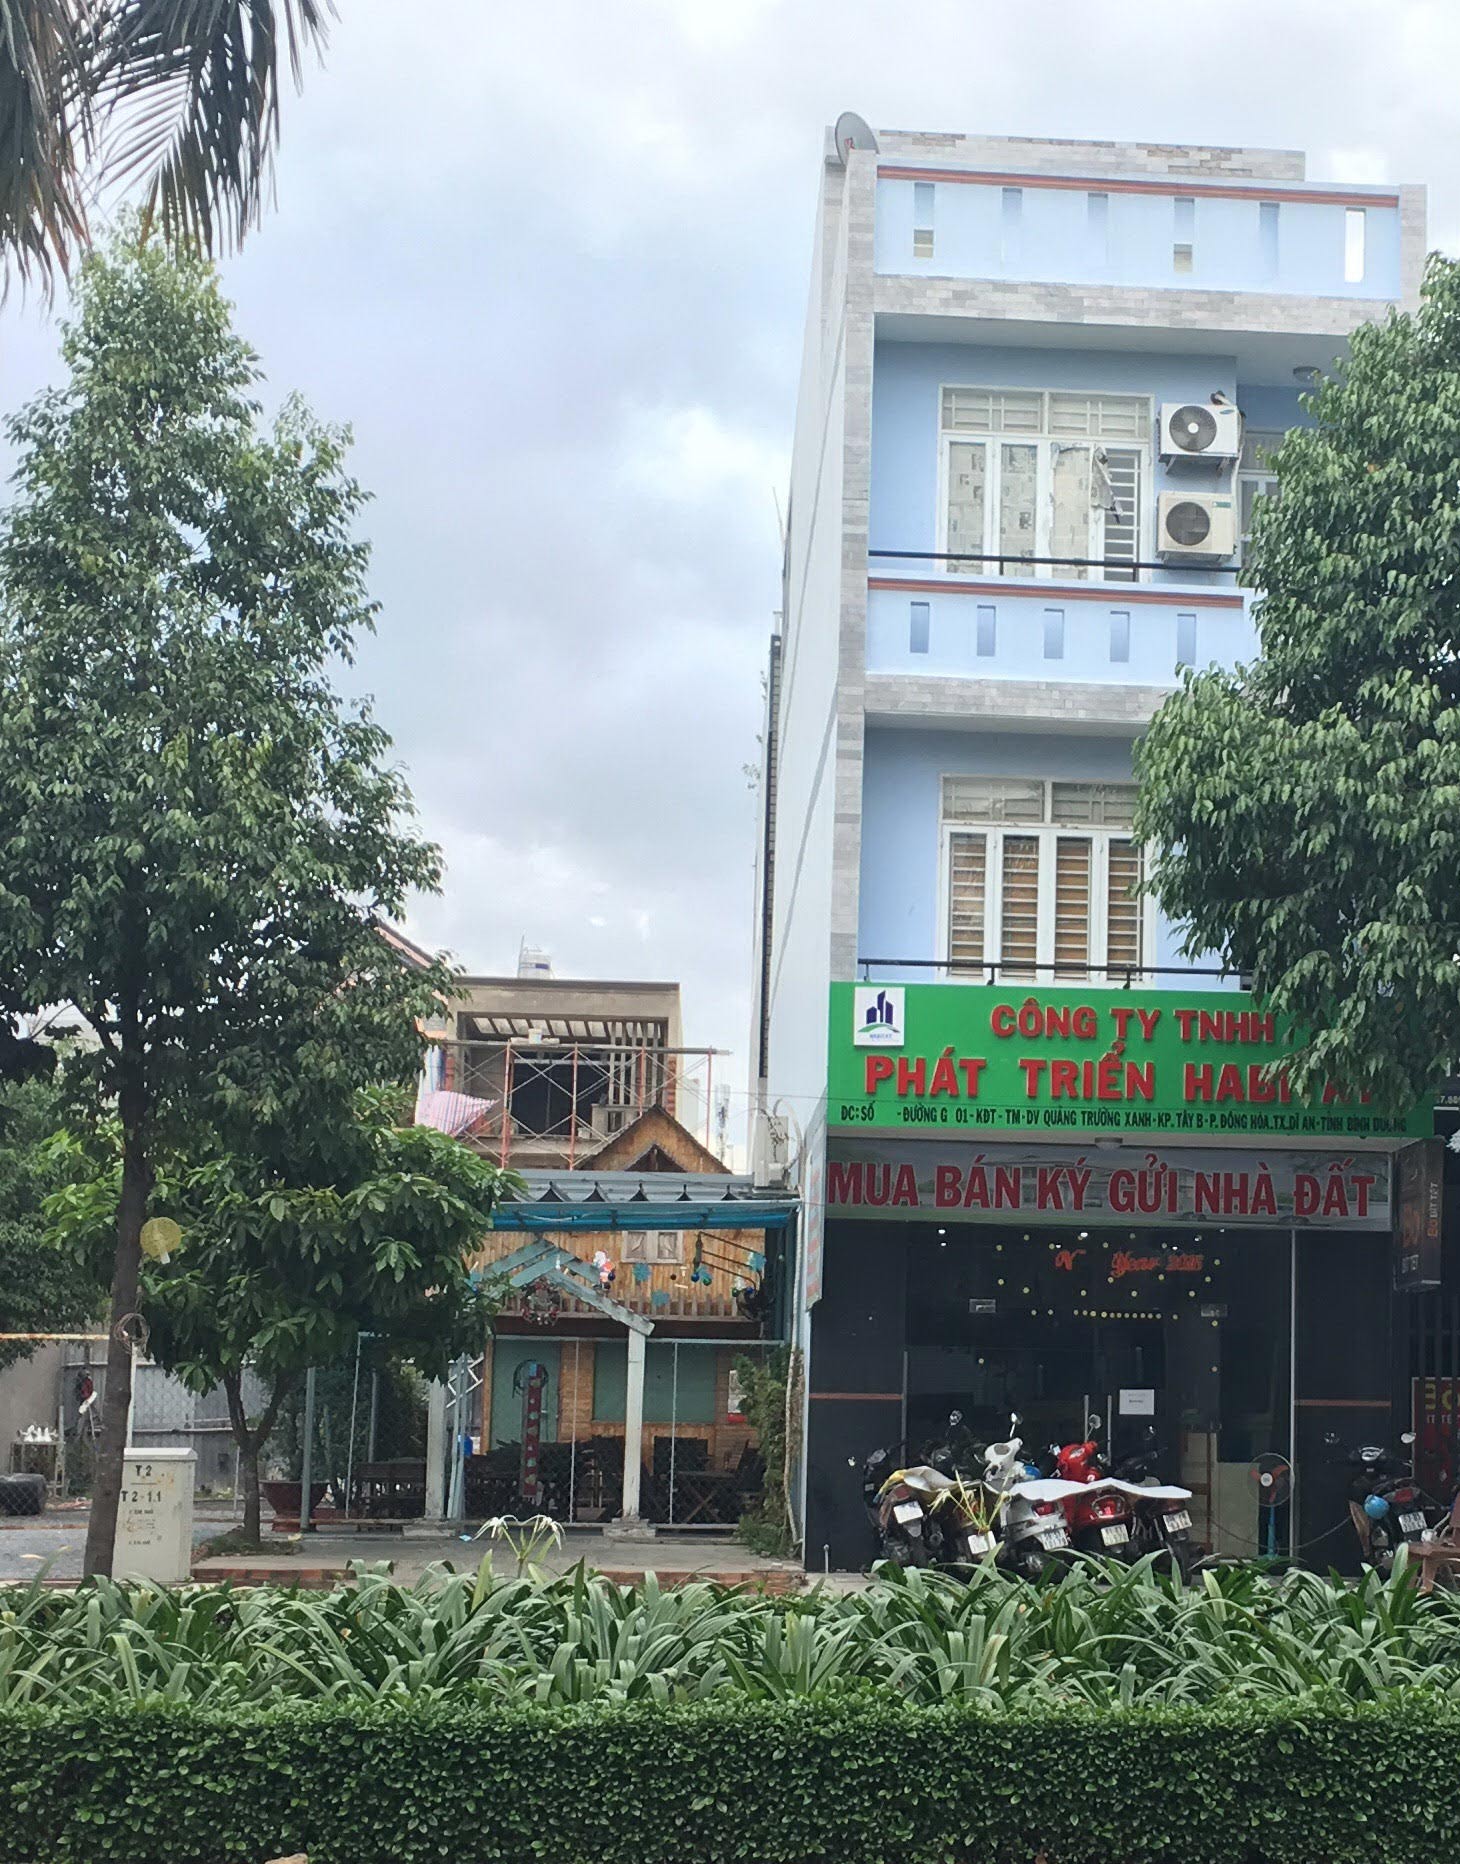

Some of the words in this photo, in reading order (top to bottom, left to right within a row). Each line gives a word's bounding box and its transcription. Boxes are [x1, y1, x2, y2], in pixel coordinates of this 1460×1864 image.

[991, 996, 1098, 1039] CÔNG
[1109, 1007, 1161, 1040] TY
[1173, 1008, 1276, 1044] TNHH
[864, 1045, 987, 1097] PHÁT
[1018, 1040, 1155, 1100] TRIỂN
[1043, 1105, 1077, 1127] QUẢNG
[1080, 1106, 1121, 1127] TRƯỜNG
[828, 1161, 919, 1207] MUA
[935, 1154, 1022, 1209] BÁN
[1037, 1156, 1092, 1211] KÝ
[1109, 1153, 1178, 1214] GỬI
[1195, 1161, 1277, 1216] NHÀ
[1294, 1158, 1376, 1218] ĐẤT
